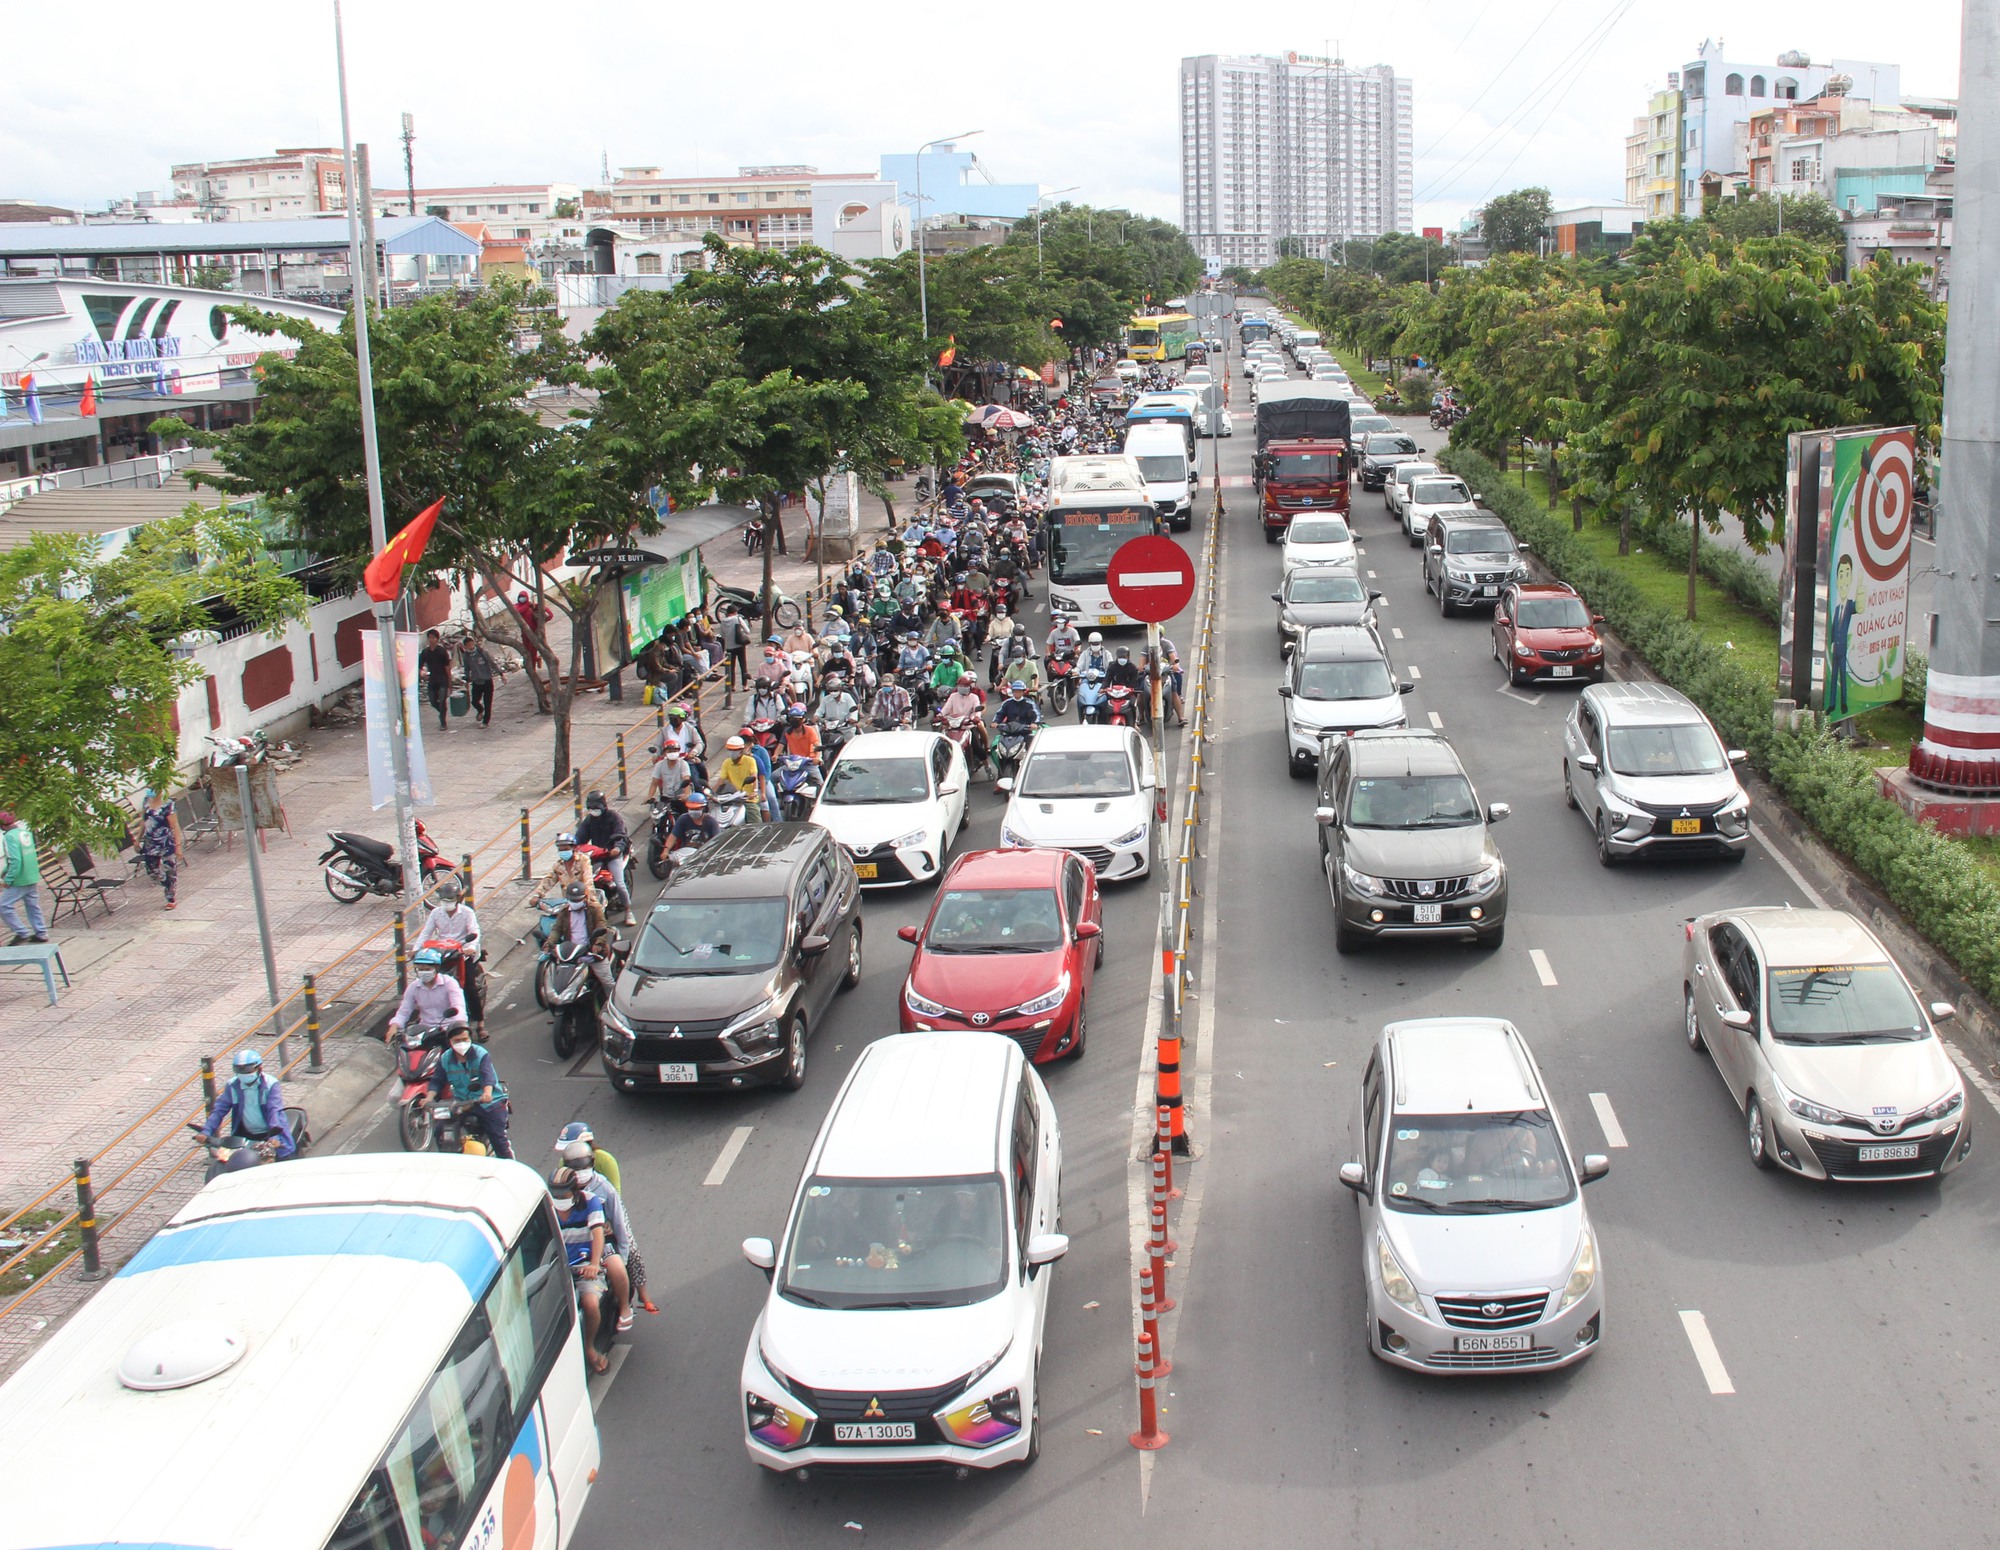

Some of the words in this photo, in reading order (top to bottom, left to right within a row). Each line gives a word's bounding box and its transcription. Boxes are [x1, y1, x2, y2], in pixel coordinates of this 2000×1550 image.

[105, 340, 125, 361] XE
[101, 363, 132, 377] TICKET
[134, 360, 161, 373] OFFIC
[1857, 613, 1885, 636] QUẢNG
[1420, 905, 1435, 914] 51D
[670, 1065, 687, 1073] 92A
